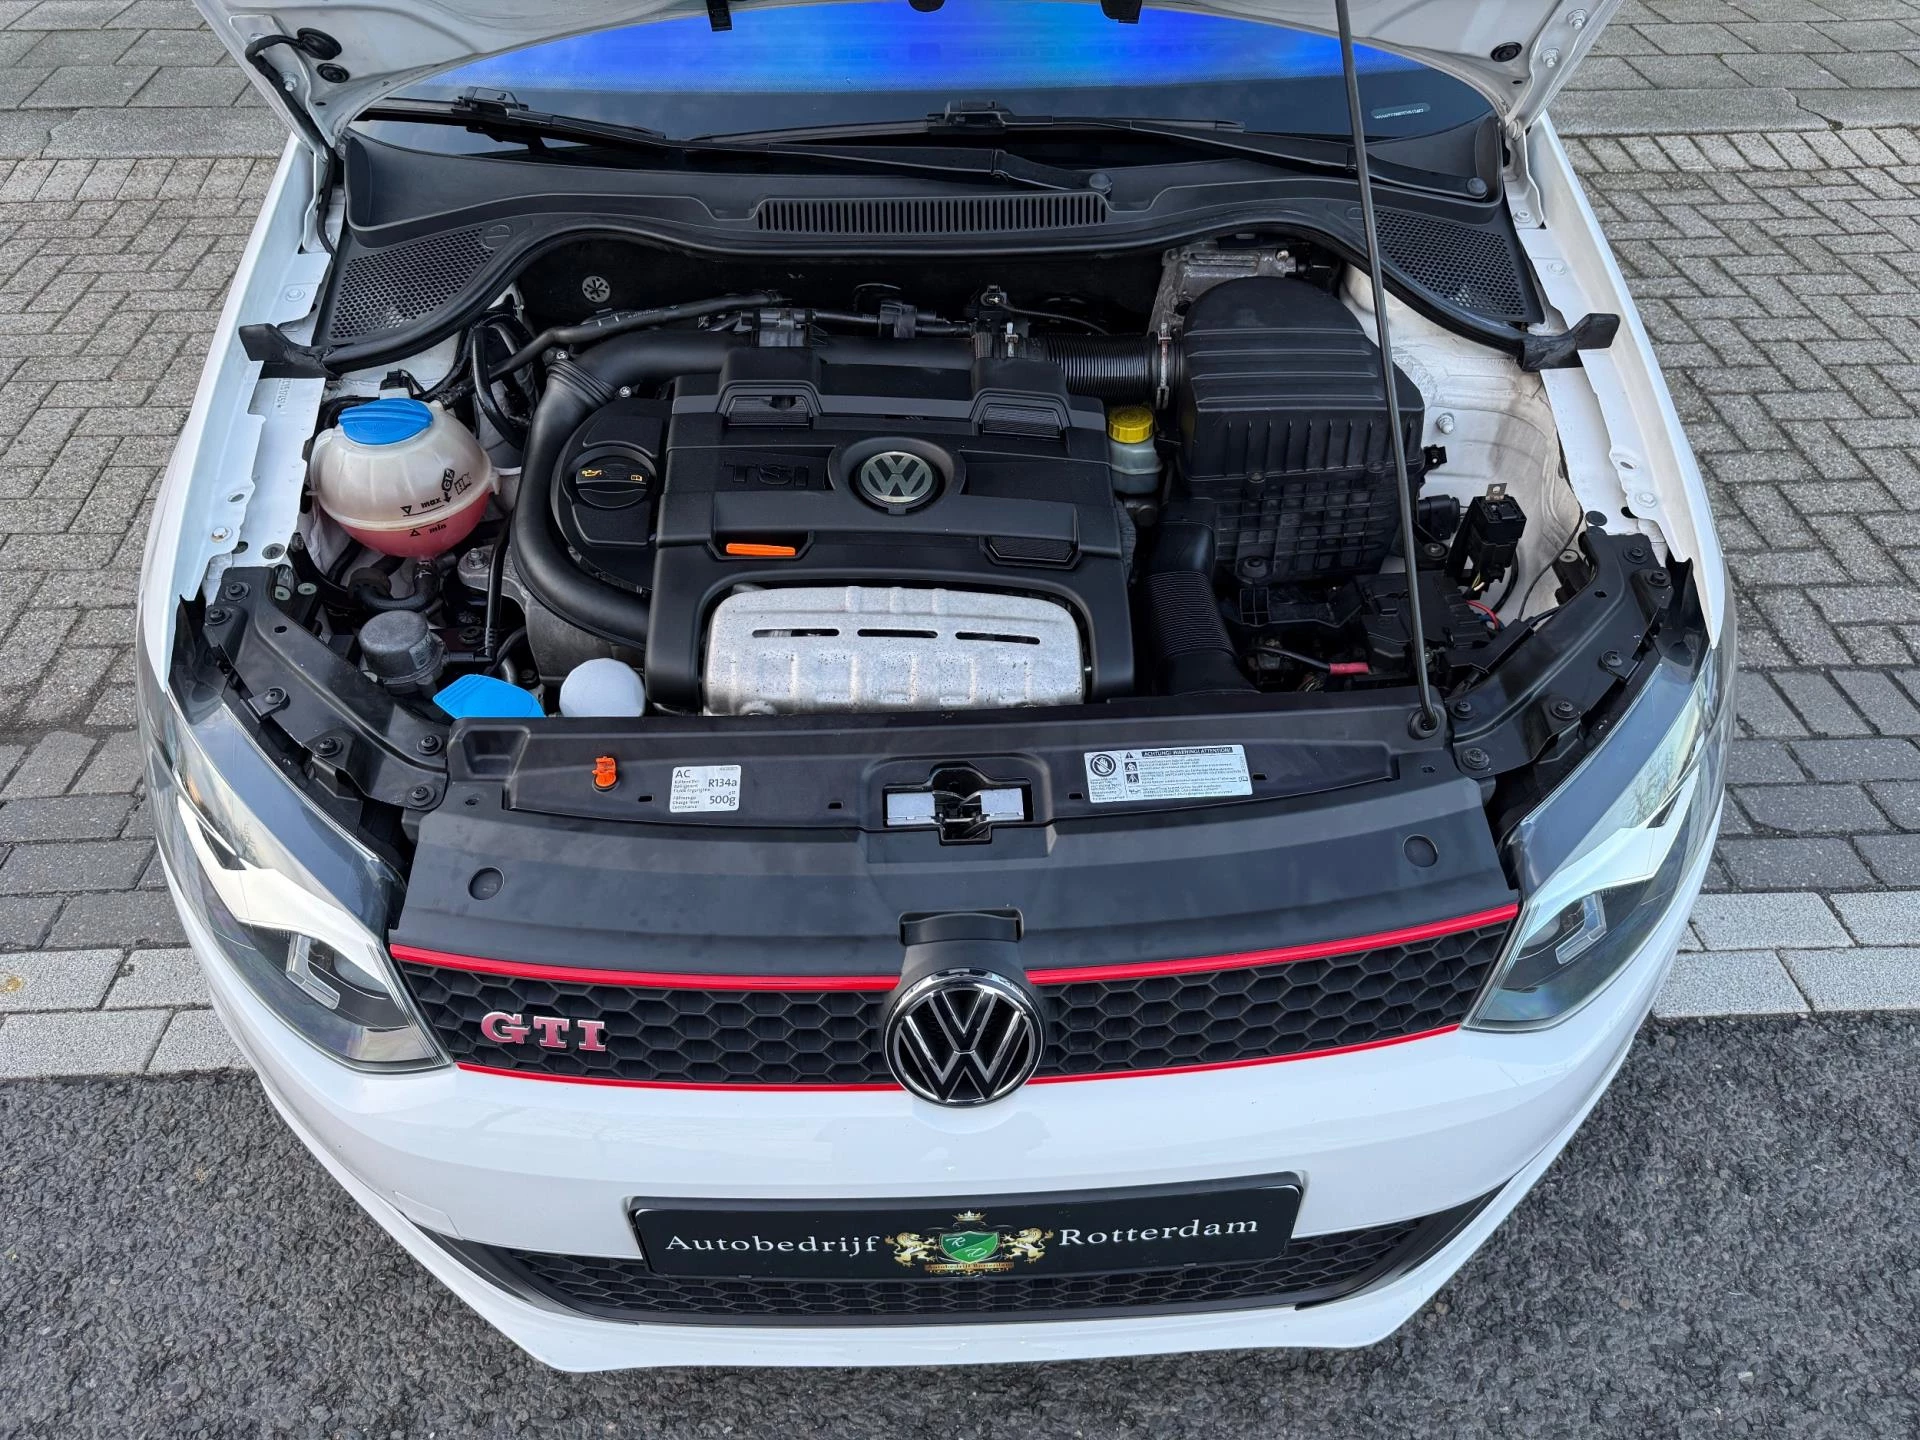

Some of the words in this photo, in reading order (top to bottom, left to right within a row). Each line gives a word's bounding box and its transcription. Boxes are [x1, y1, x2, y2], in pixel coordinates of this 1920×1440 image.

[723, 461, 809, 486] TSI
[421, 497, 442, 508] max
[429, 523, 447, 534] min
[675, 769, 691, 778] AC
[708, 778, 737, 788] R134a
[709, 795, 736, 807] 500g
[480, 1011, 606, 1052] GTI
[1058, 1218, 1258, 1246] Rotterdam
[665, 1235, 880, 1257] Autobedrijf
